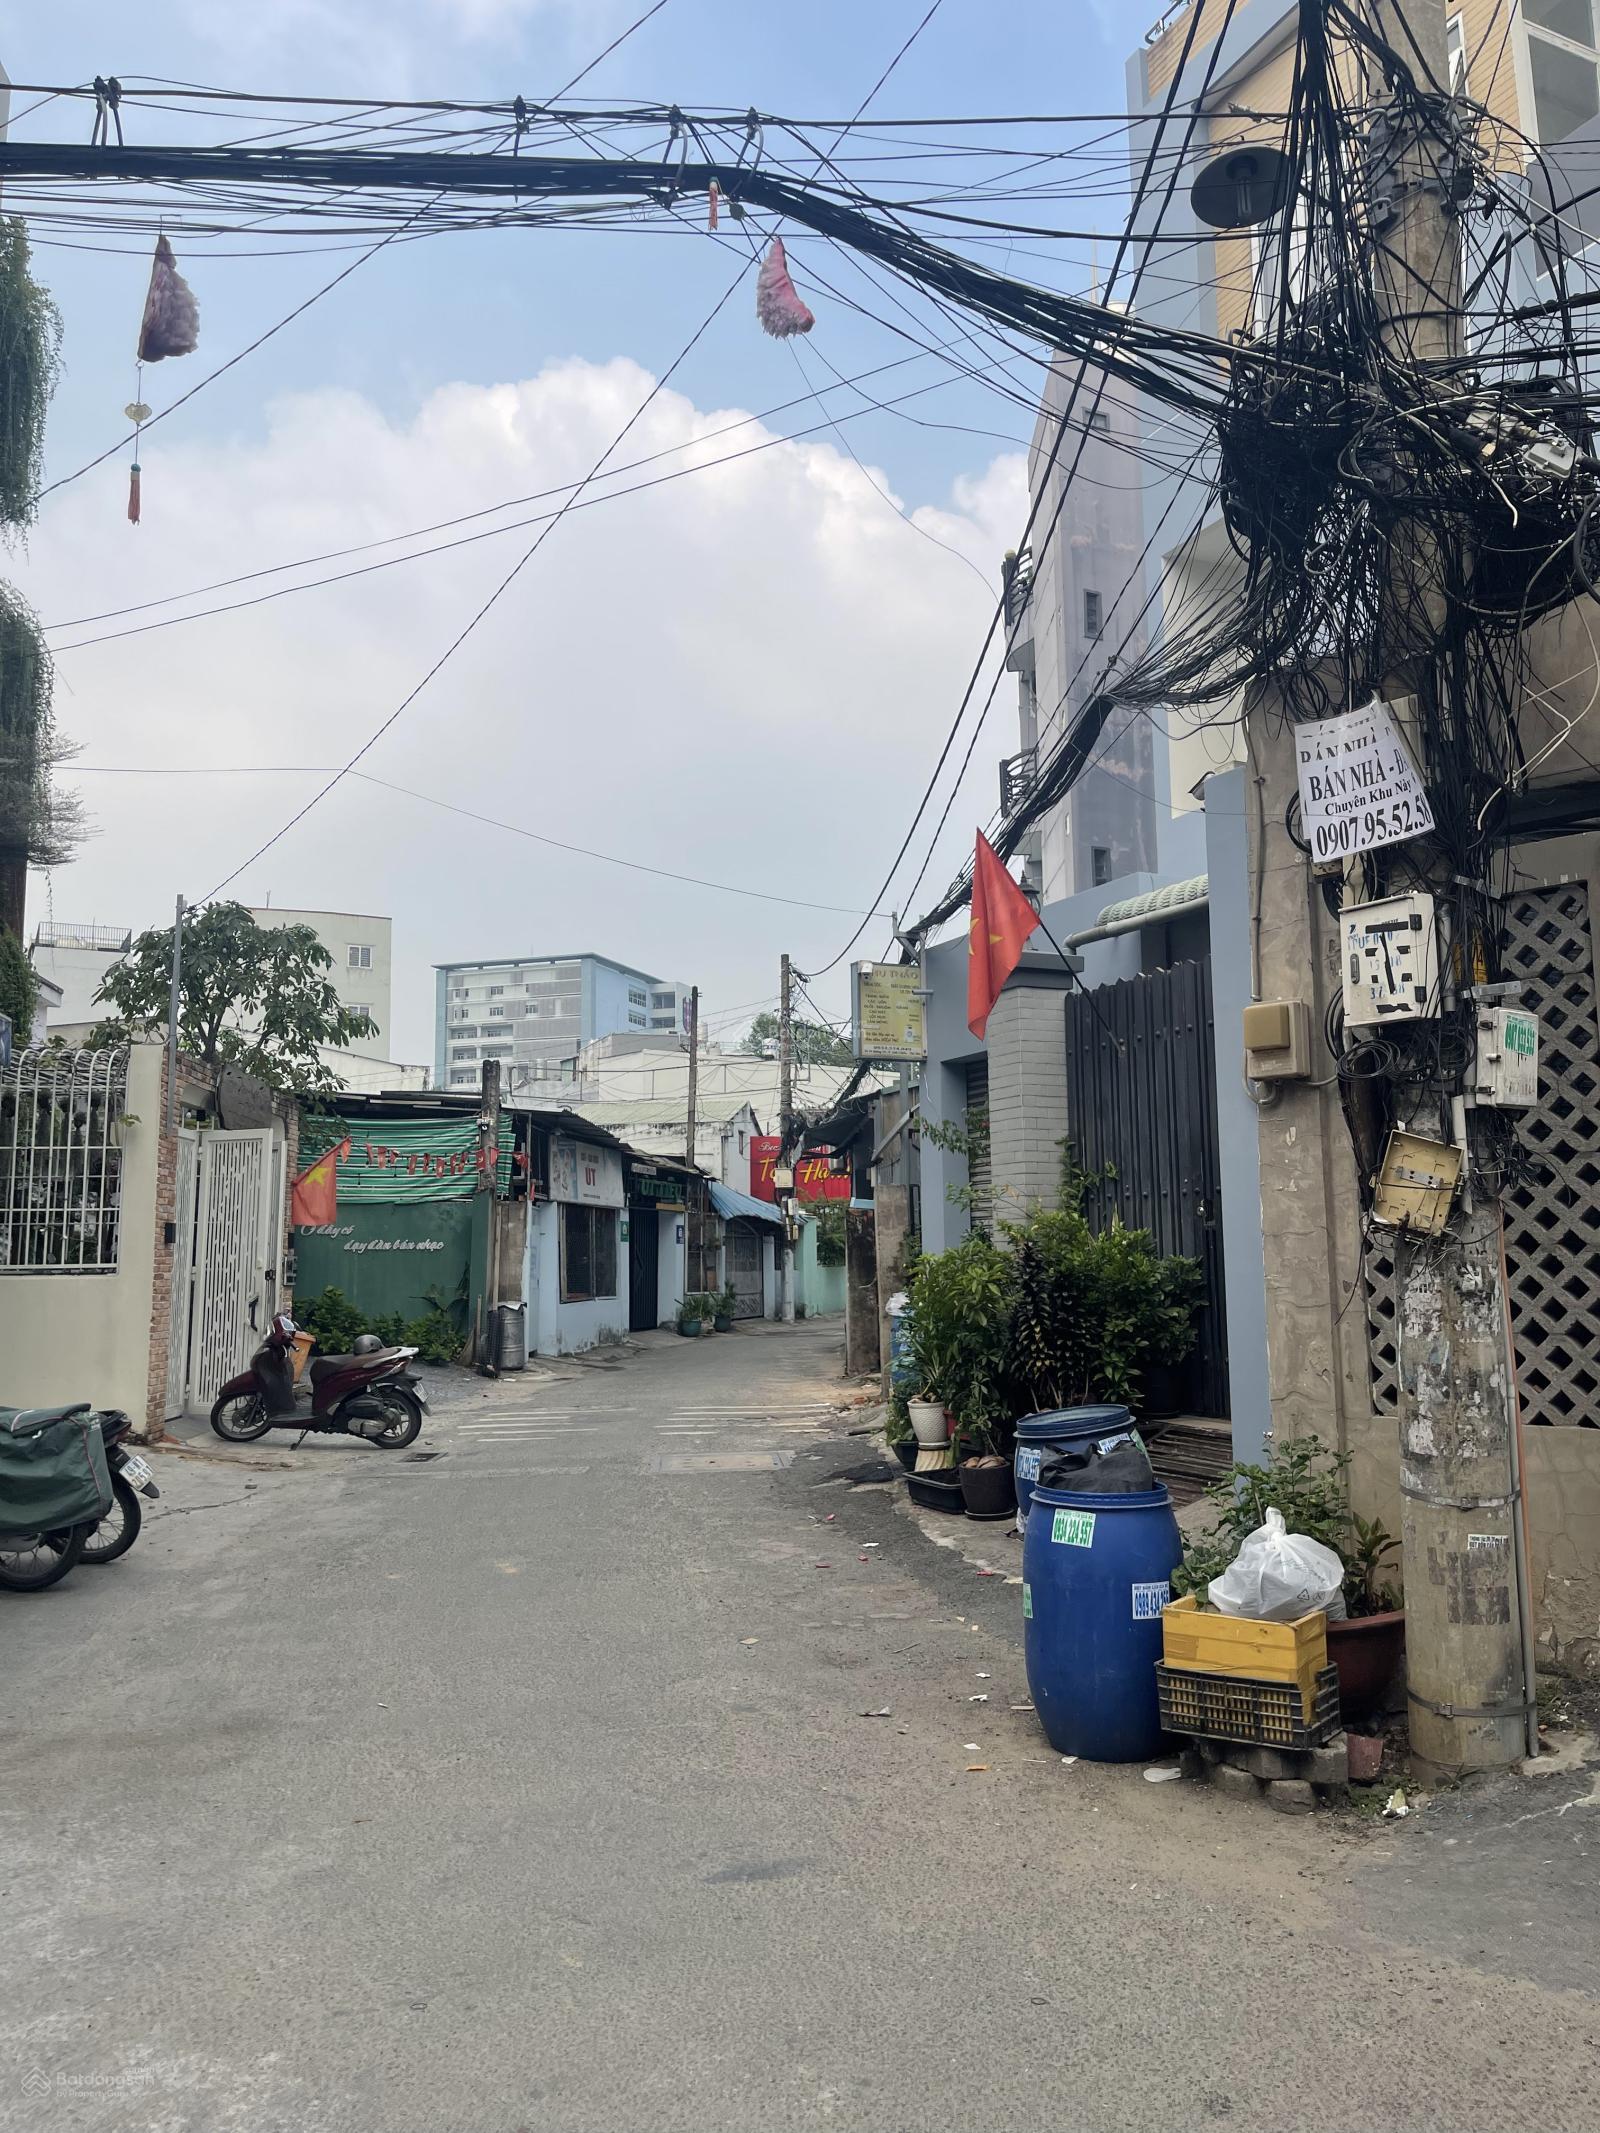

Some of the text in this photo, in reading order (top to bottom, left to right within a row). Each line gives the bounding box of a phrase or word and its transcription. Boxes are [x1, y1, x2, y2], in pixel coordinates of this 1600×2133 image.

[1308, 765, 1348, 802] BÁN
[1349, 749, 1387, 792] NHÀ
[1324, 795, 1367, 816] Chuyên
[1369, 784, 1393, 804] Khu
